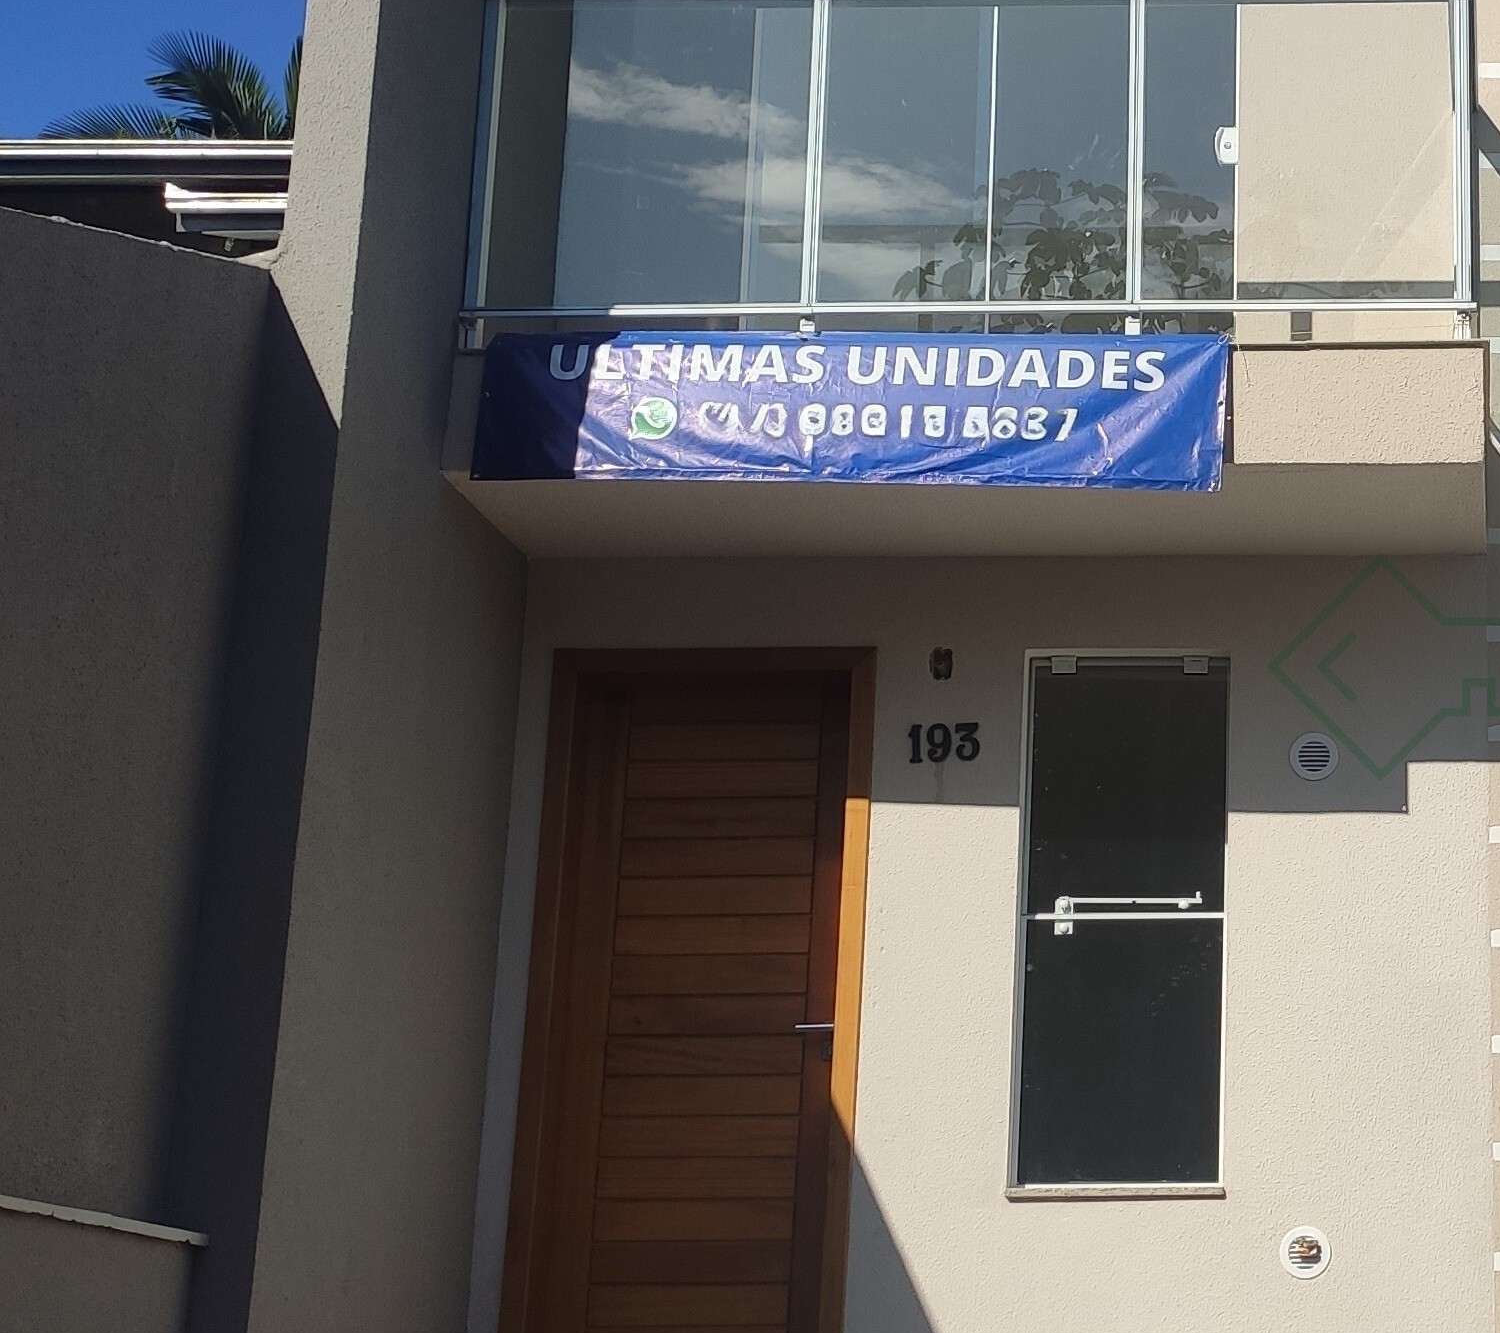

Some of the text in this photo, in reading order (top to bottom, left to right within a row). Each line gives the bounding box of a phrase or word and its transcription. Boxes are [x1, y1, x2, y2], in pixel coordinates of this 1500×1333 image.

[549, 344, 1167, 391] ULTIMAS UNIDADES
[908, 722, 980, 764] 193
